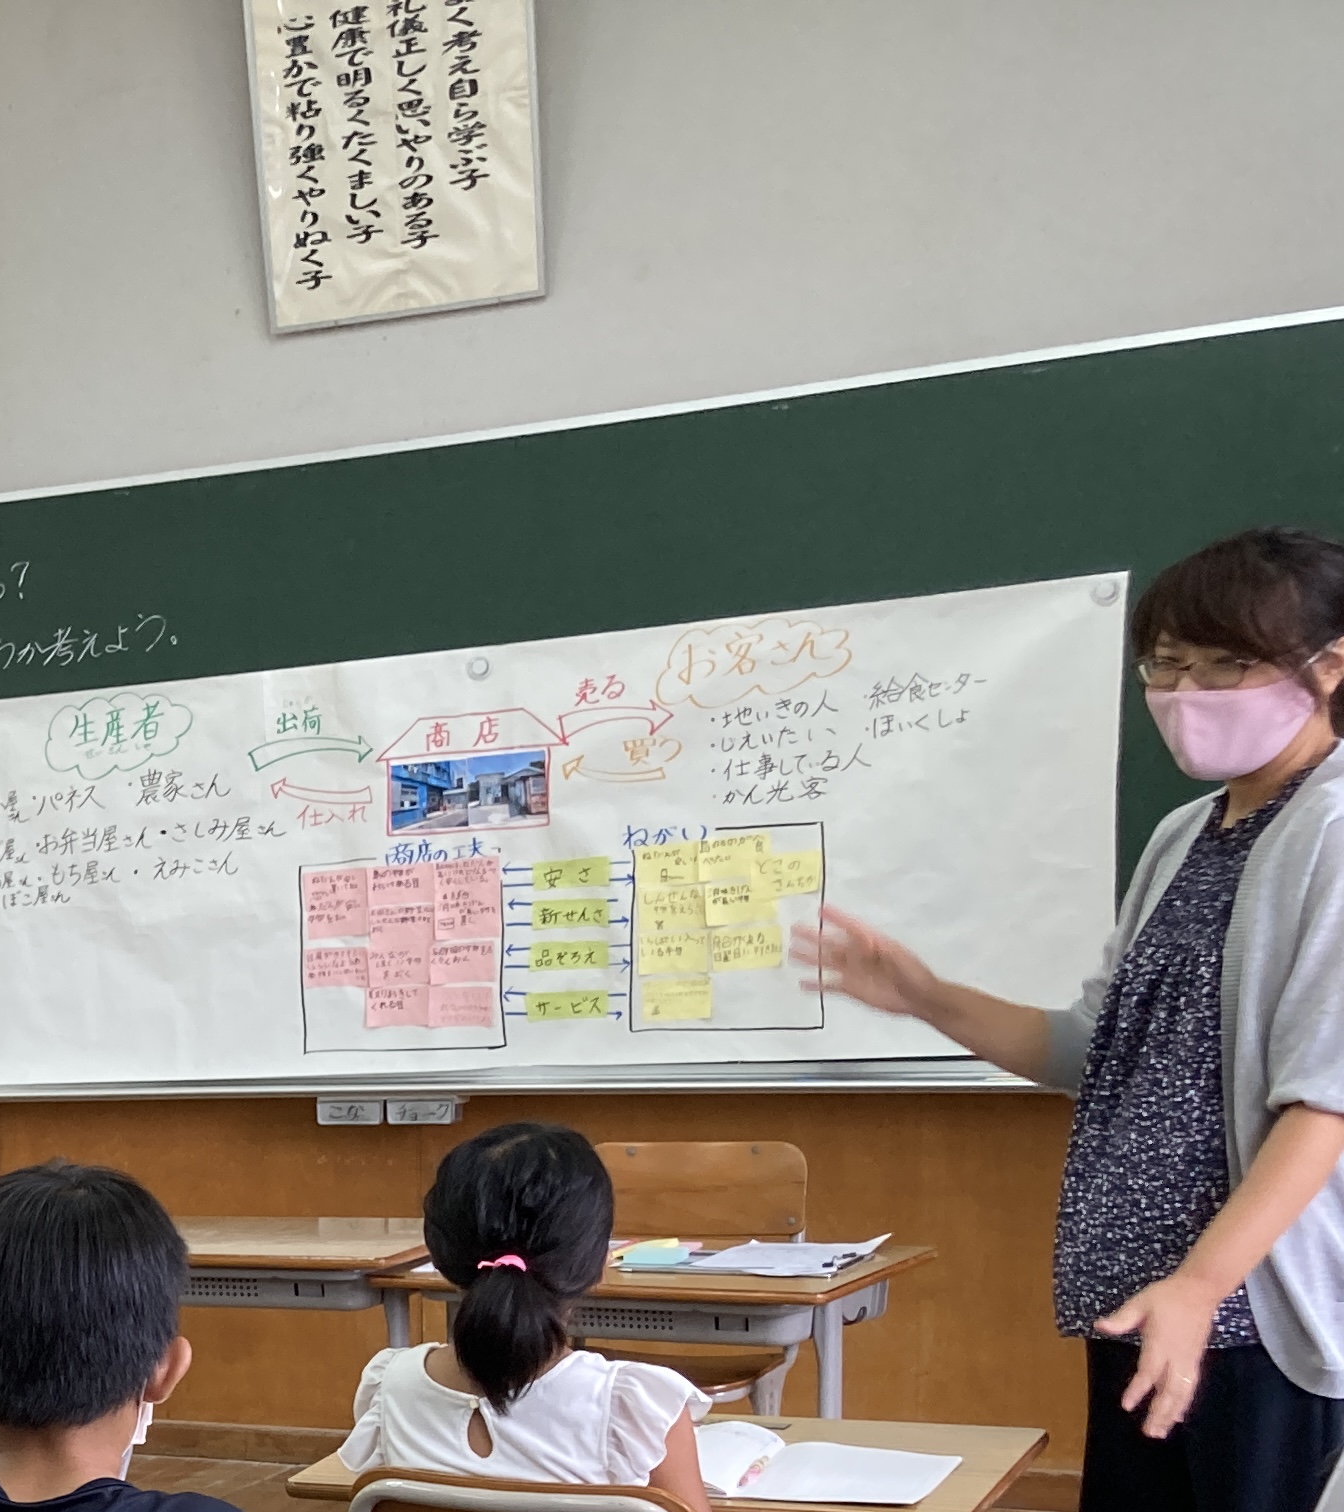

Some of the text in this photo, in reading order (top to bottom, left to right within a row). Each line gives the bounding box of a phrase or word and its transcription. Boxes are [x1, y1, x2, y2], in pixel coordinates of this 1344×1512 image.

[328, 5, 384, 244] 健康で明るくたくましい子
[677, 631, 828, 685] お客さん
[573, 673, 626, 708] 売る
[68, 699, 165, 748] 生産者
[275, 705, 323, 735] 出荷
[425, 714, 501, 753] 商店
[623, 736, 684, 766] 買う
[296, 803, 370, 830] 仕入れ
[622, 824, 708, 849] ねがい
[385, 836, 487, 866] 商店の工夫
[543, 866, 592, 889] 安さ
[539, 906, 605, 926] 新せんさ
[534, 948, 598, 968] 品ぞろえ
[535, 996, 603, 1017] サービス
[327, 1104, 366, 1122] こな
[395, 1103, 451, 1121] チョーク
